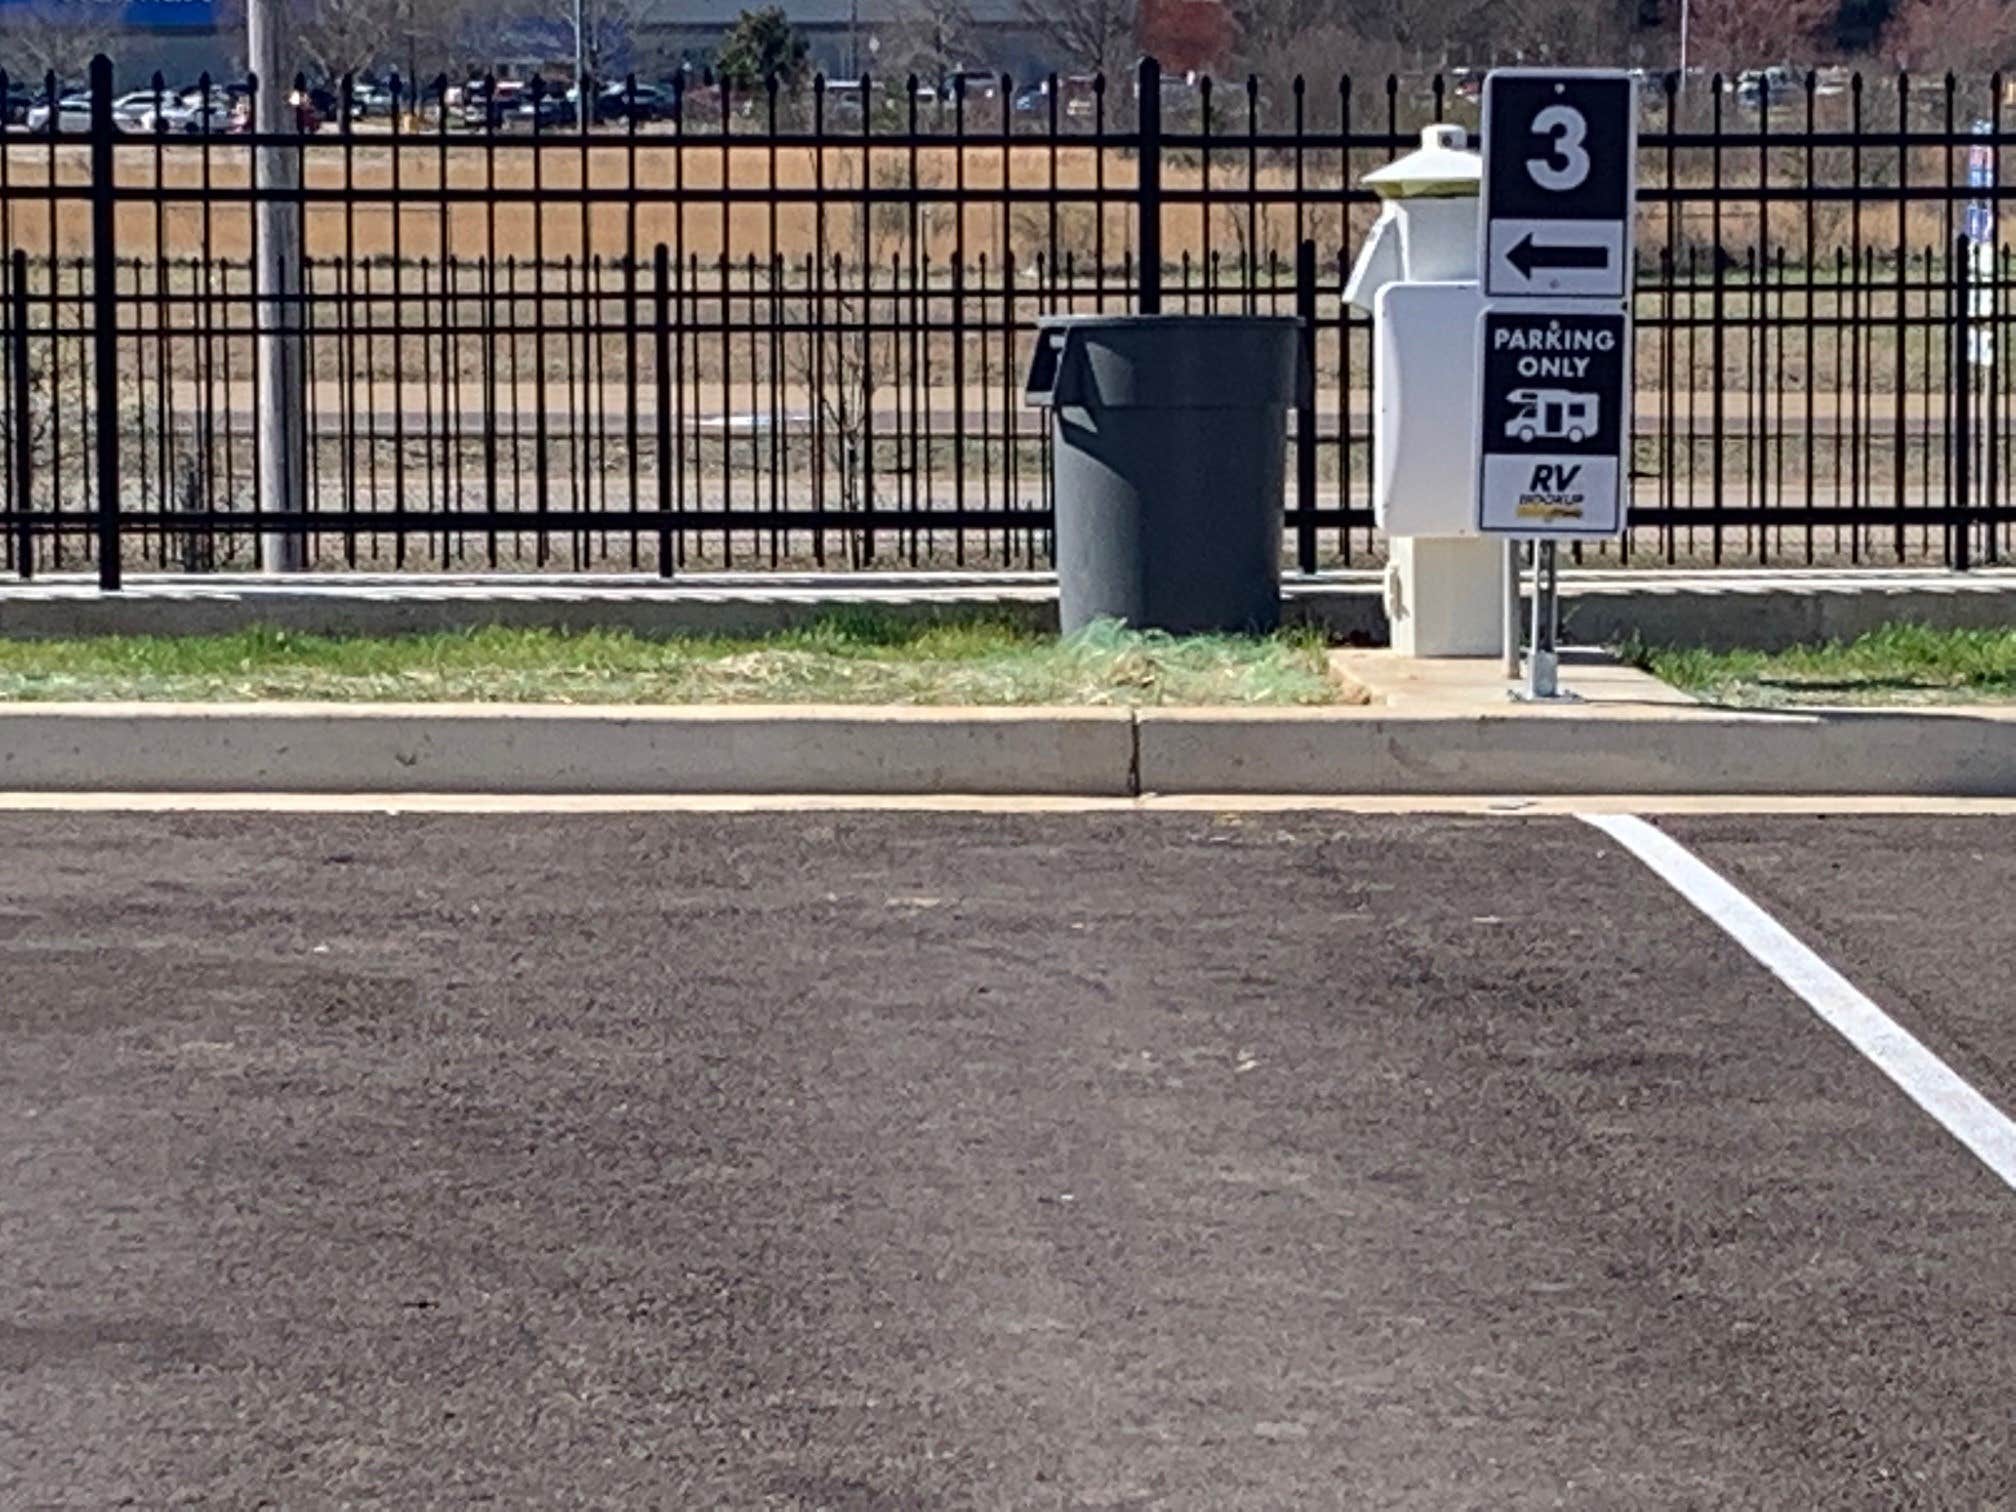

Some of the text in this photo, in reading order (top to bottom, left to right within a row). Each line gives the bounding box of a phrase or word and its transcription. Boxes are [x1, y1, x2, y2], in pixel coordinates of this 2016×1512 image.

[1526, 105, 1590, 190] 3
[1494, 328, 1615, 351] PARKING
[1517, 356, 1590, 378] ONLY
[1529, 464, 1582, 492] RV
